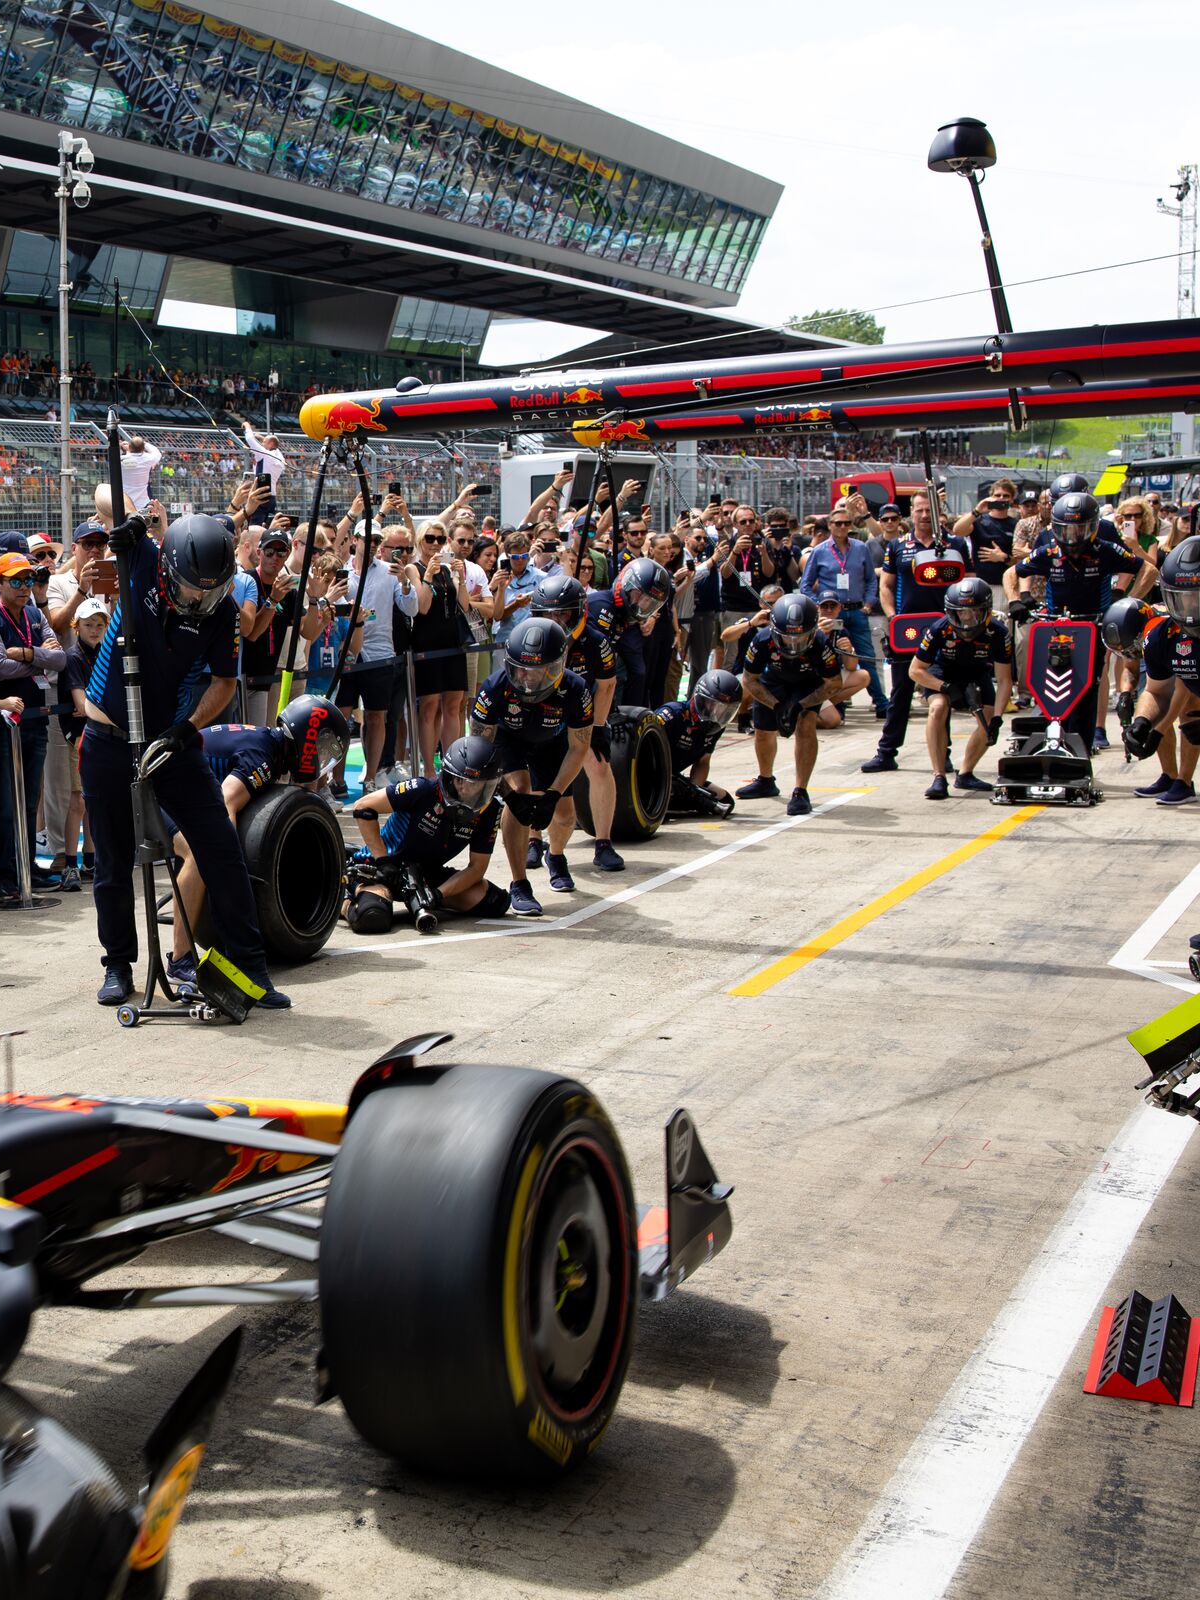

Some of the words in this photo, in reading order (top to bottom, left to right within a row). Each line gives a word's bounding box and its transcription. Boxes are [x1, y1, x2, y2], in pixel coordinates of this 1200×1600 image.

[510, 393, 534, 408] Red
[535, 391, 560, 406] Bull
[512, 407, 608, 421] RACING
[754, 412, 775, 425] Red
[775, 410, 796, 423] Bull
[755, 423, 834, 434] RACING
